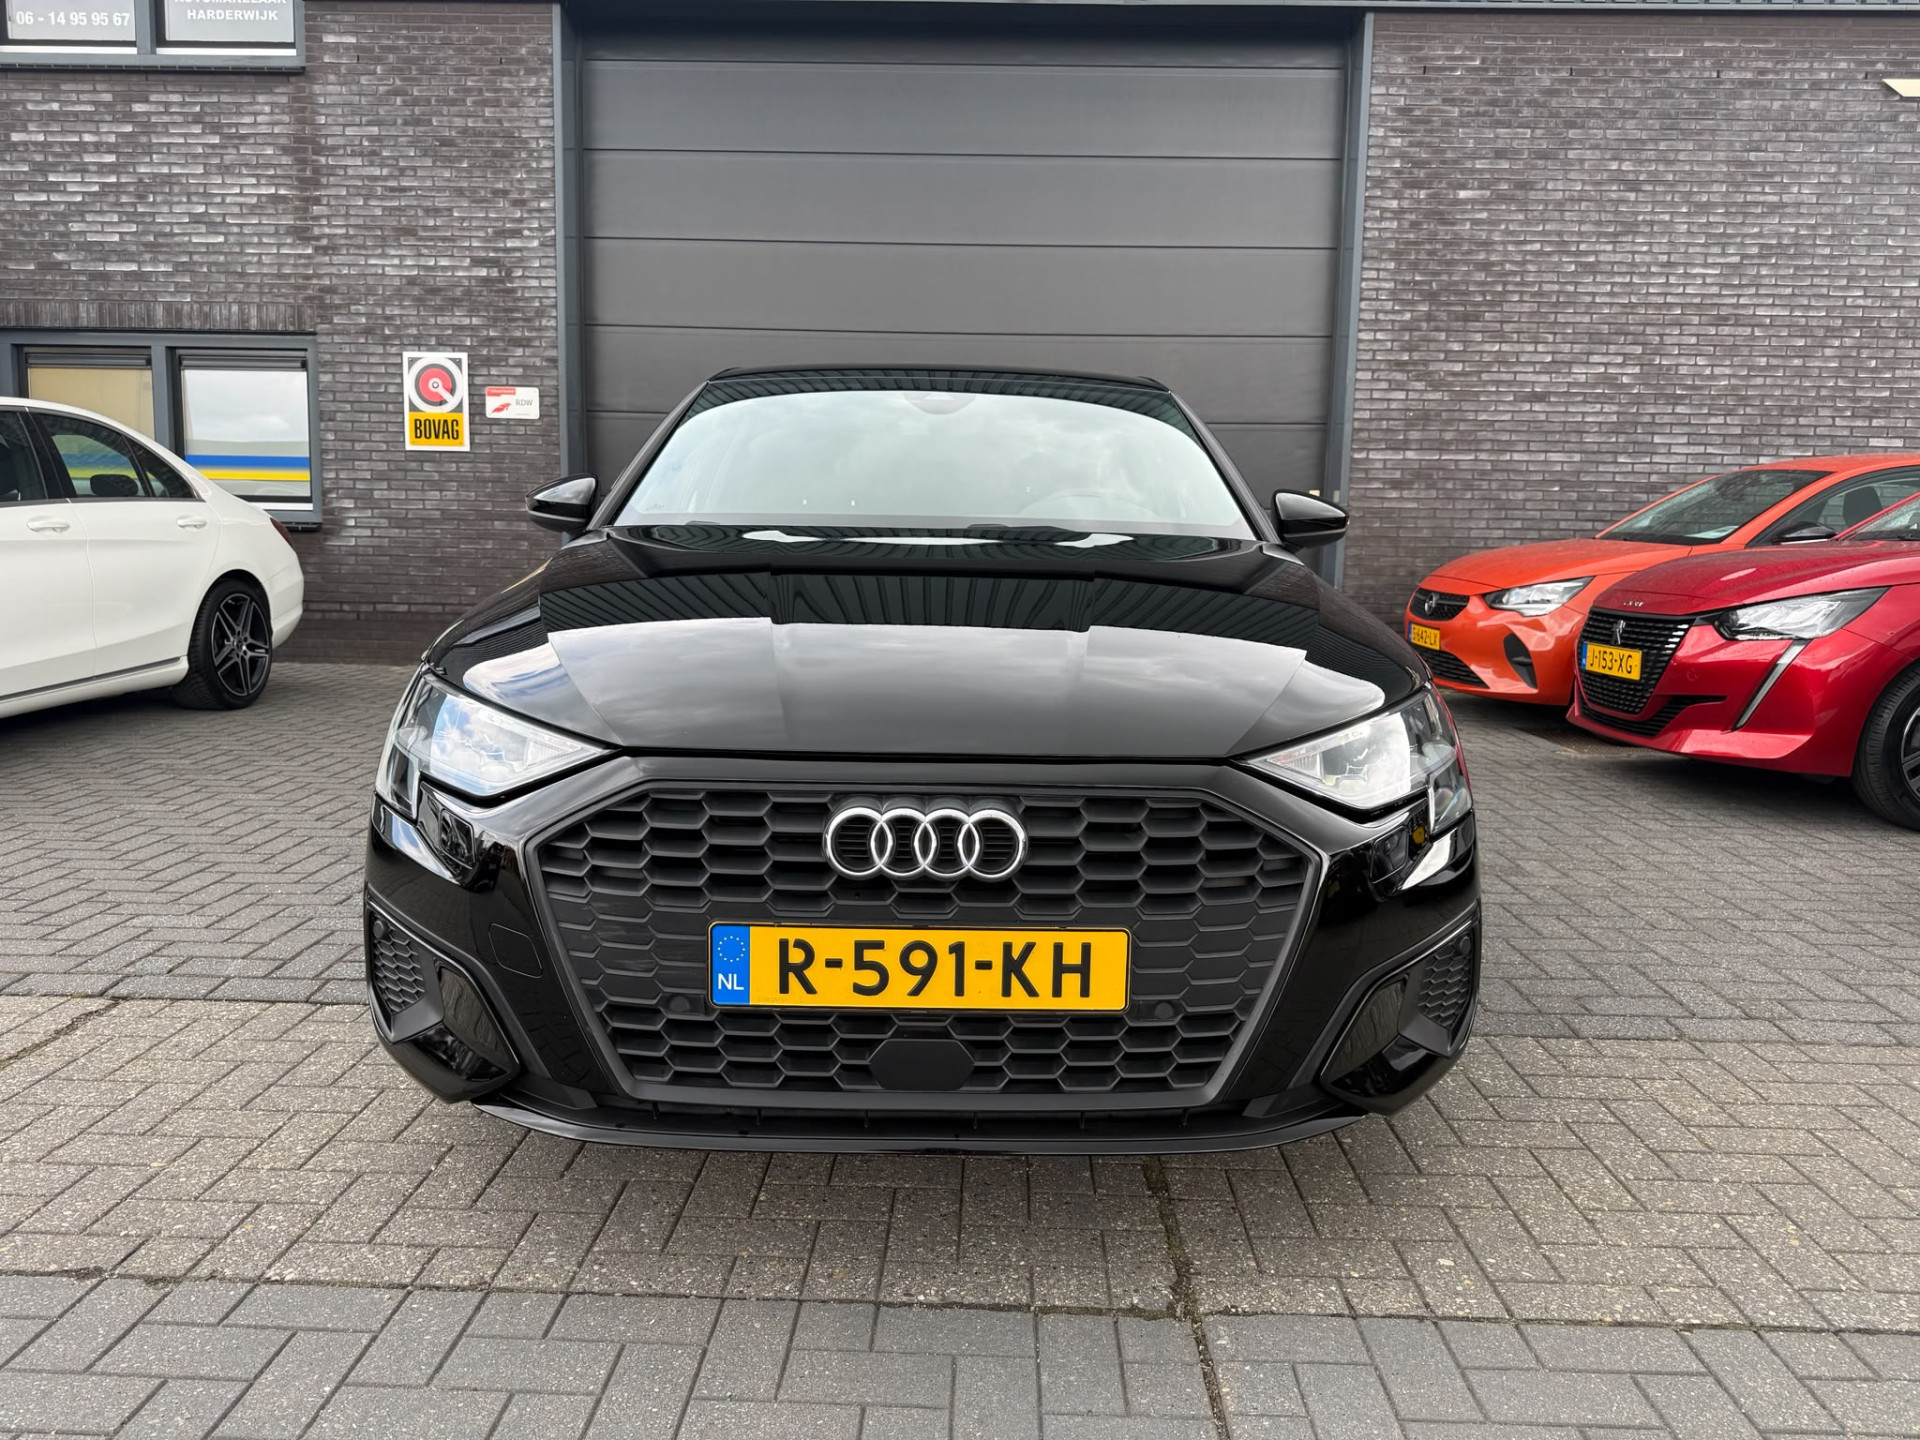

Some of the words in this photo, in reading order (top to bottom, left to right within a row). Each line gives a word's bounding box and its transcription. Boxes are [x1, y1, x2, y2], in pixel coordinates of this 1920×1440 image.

[16, 11, 34, 25] 06
[48, 12, 66, 25] 14
[69, 12, 87, 26] 95
[91, 12, 109, 26] 95
[113, 12, 130, 26] 67
[187, 9, 278, 20] HARDERWIJK
[414, 418, 460, 440] BOVAG
[1590, 648, 1633, 674] J-153-XG
[778, 938, 1092, 998] R-591-KH
[718, 973, 744, 990] NL
